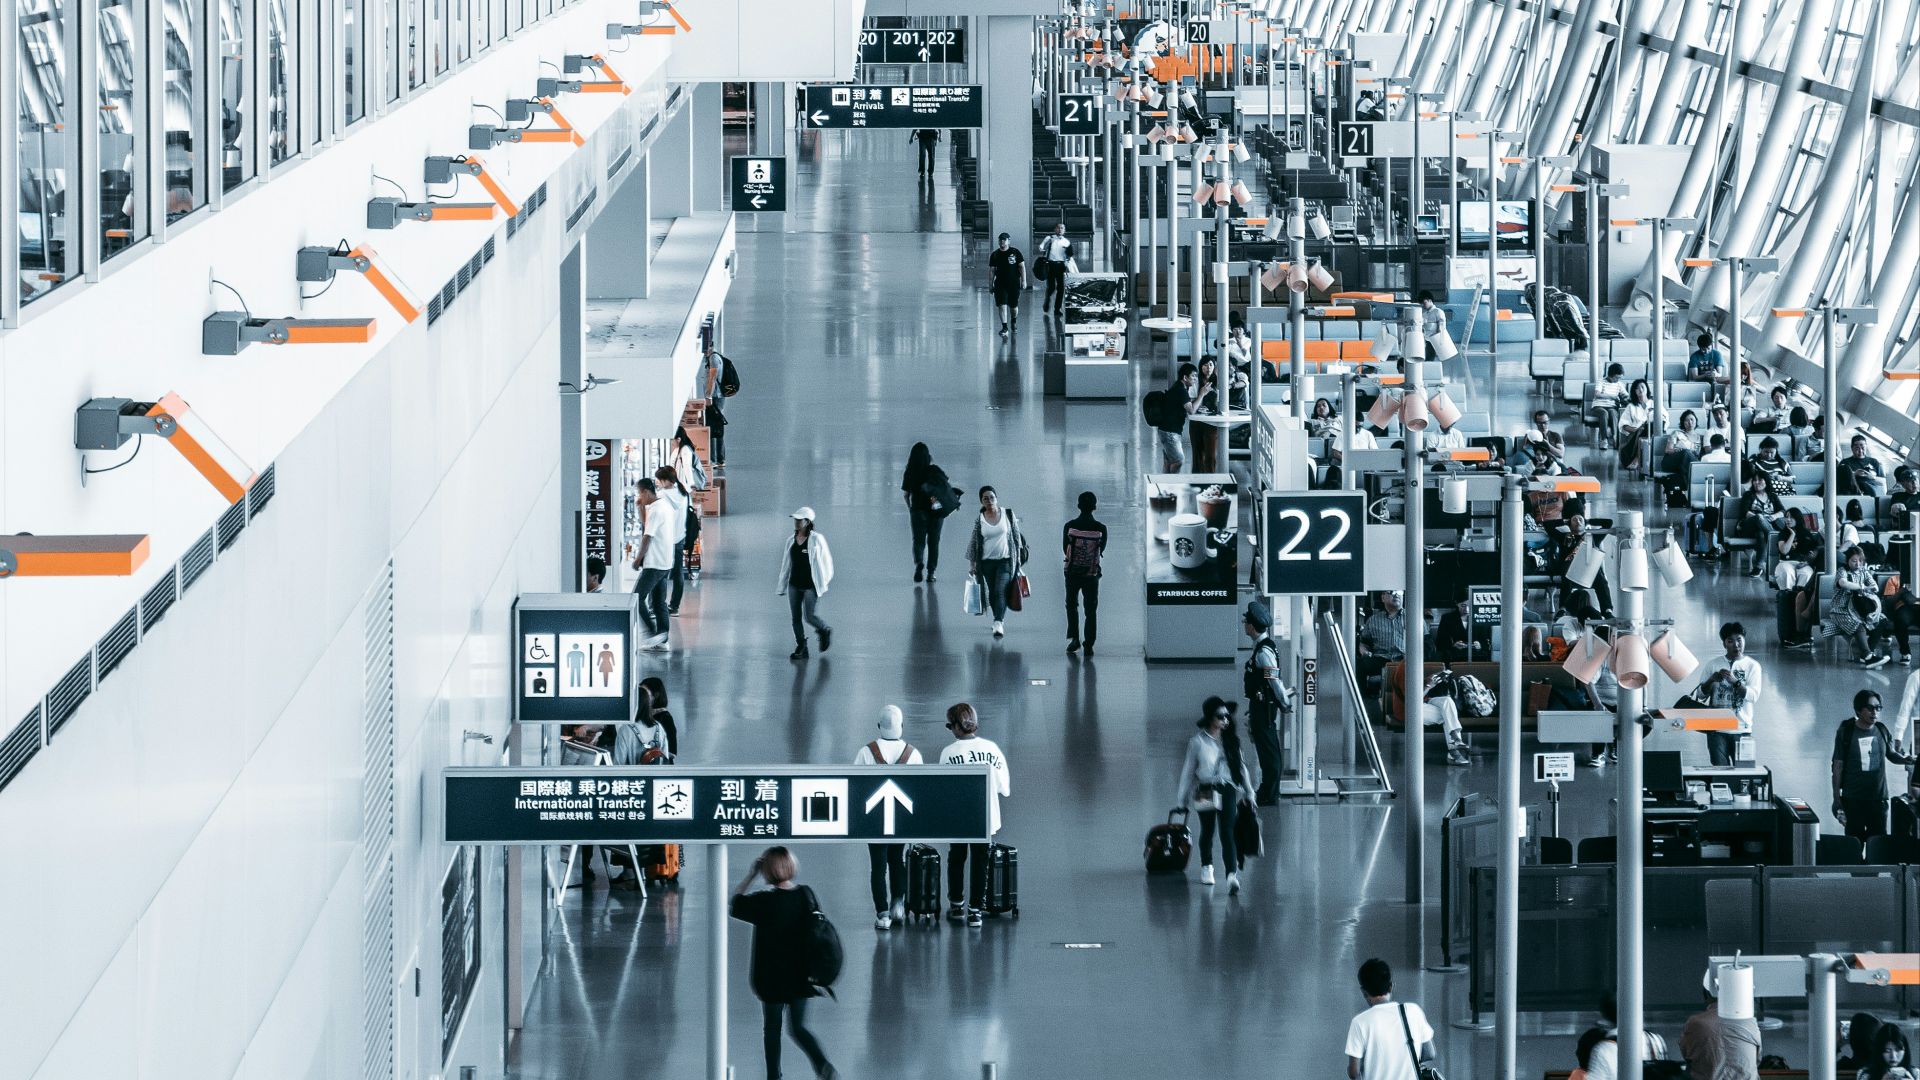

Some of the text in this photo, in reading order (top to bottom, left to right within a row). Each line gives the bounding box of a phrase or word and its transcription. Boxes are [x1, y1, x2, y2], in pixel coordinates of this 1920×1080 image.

[1191, 23, 1207, 42] 20
[853, 101, 885, 110] Arrivals
[1065, 99, 1093, 122] 21
[1347, 127, 1368, 153] 21
[1277, 508, 1353, 561] 22
[1305, 673, 1316, 704] AED
[519, 779, 646, 797] 国際線 乗り継ぎ
[720, 779, 779, 802] 到着
[514, 797, 647, 810] International Transfer
[713, 803, 779, 820] Arrivals
[598, 811, 626, 821] 국제선
[753, 824, 779, 836] 도착
